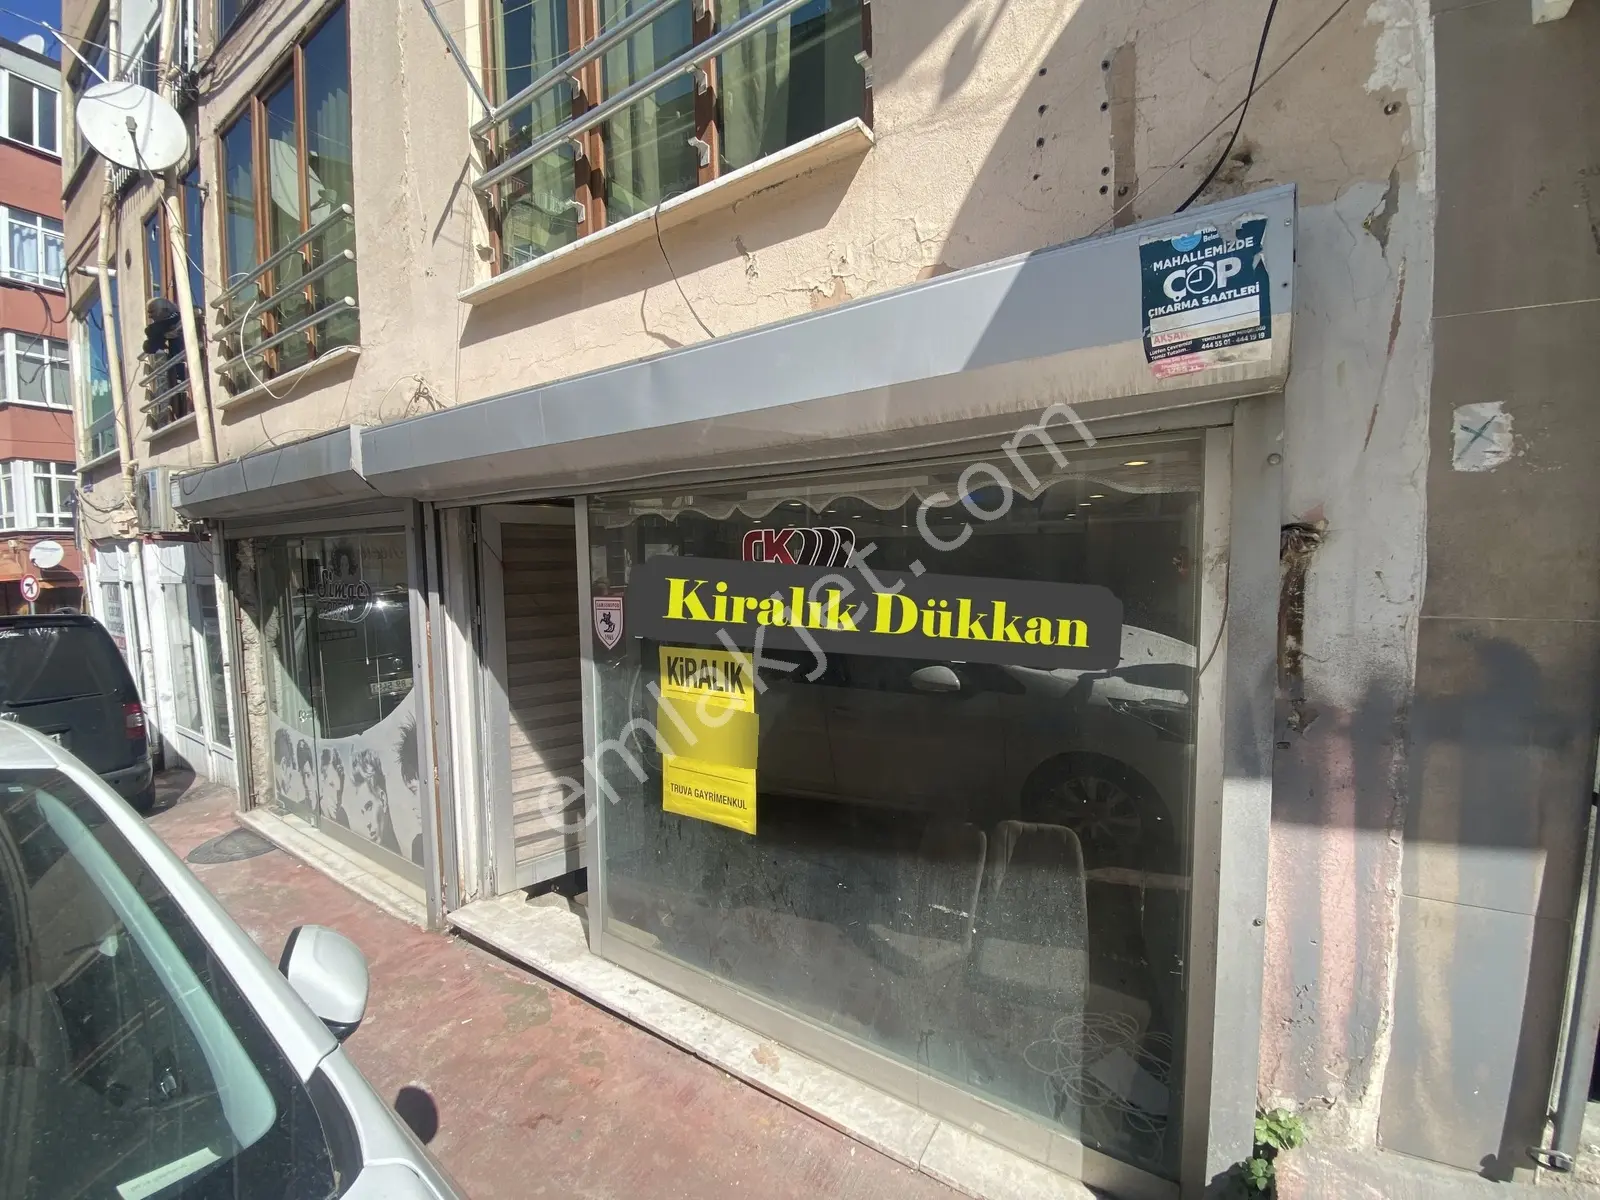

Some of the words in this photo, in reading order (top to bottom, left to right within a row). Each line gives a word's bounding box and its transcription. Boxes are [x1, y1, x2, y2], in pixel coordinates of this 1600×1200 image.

[1153, 236, 1253, 272] MAHALLEMİZDE
[1148, 298, 1200, 319] ÇIKARMA
[1201, 281, 1260, 306] SAATLERİ
[1201, 342, 1213, 350] 444
[1214, 340, 1223, 348] 55
[1223, 338, 1231, 346] 01
[1236, 335, 1248, 343] 444
[1257, 331, 1265, 339] 19
[670, 782, 693, 798] TRUVA
[694, 788, 748, 810] GAYRİMENKUL
